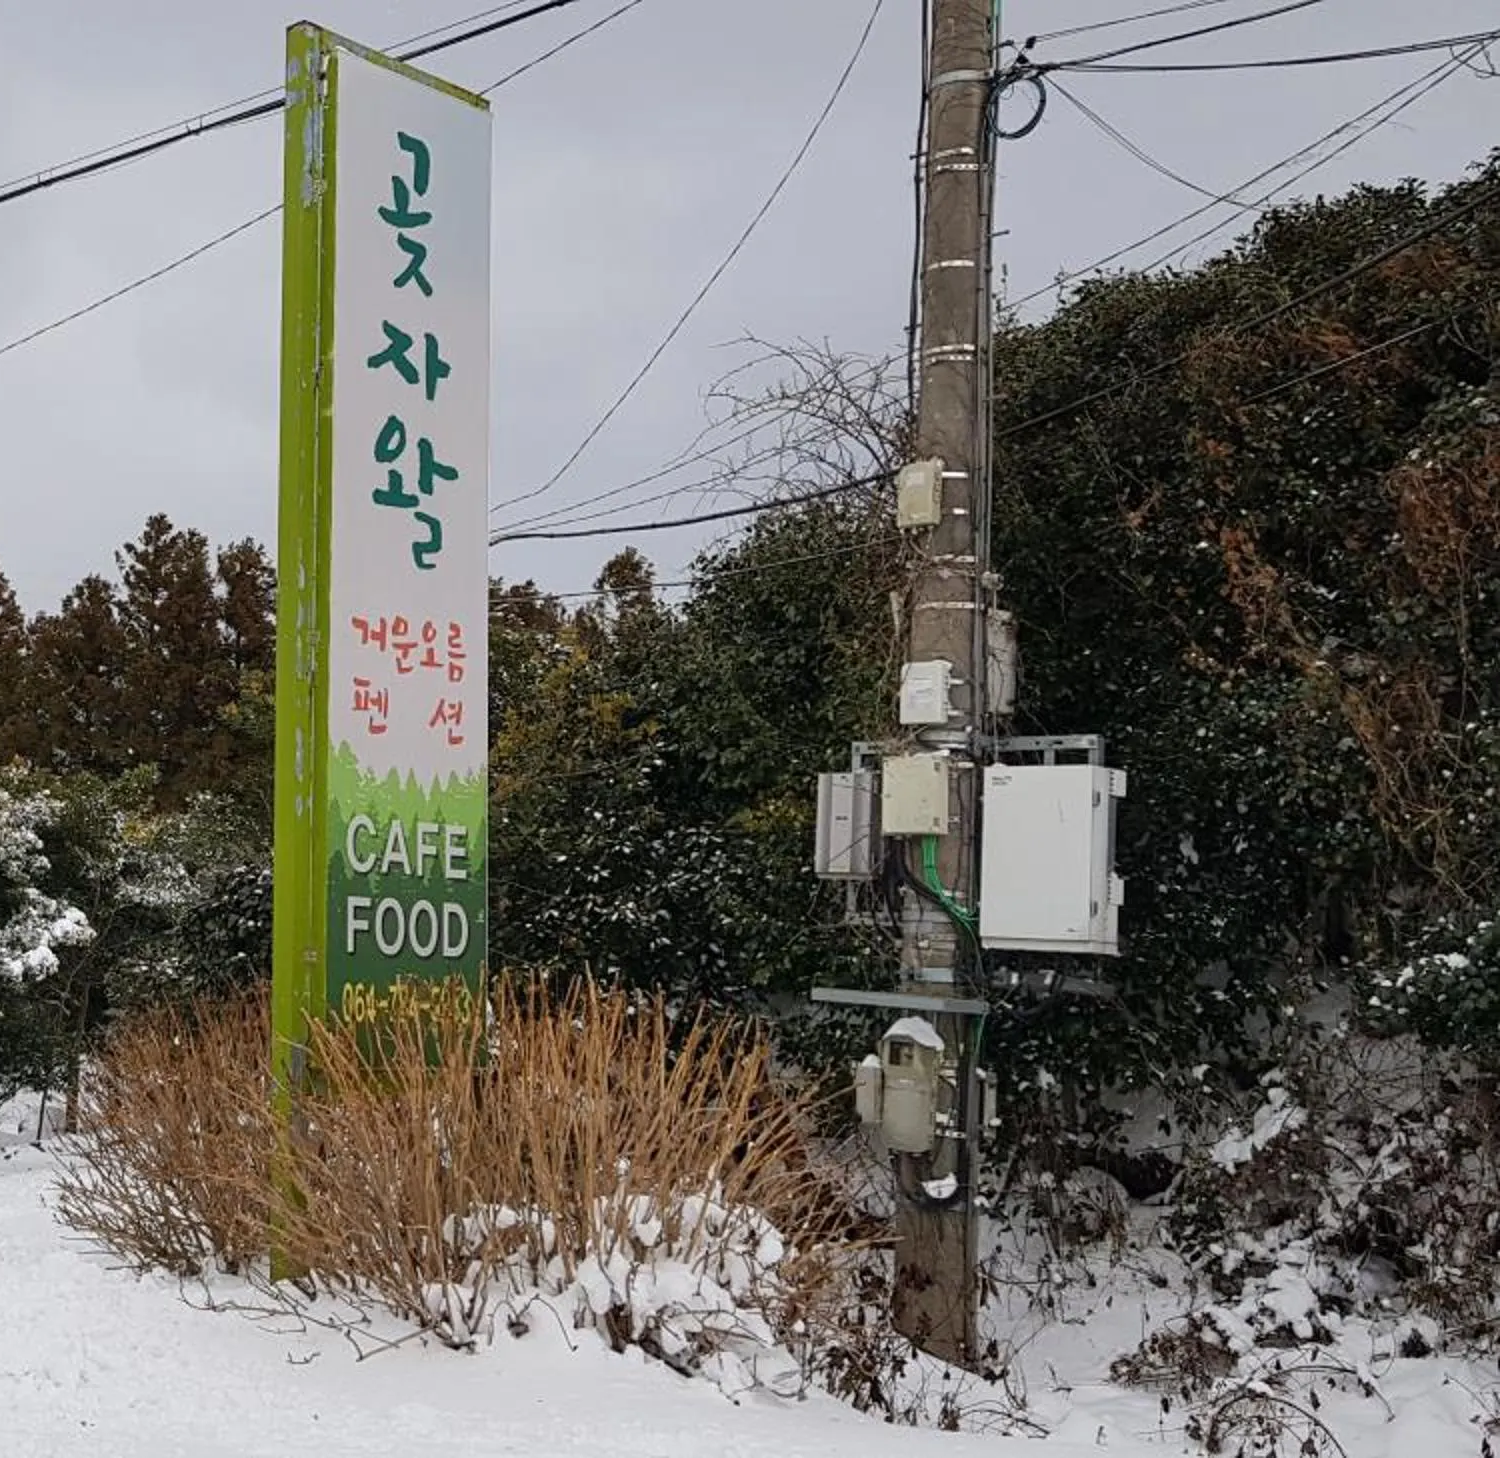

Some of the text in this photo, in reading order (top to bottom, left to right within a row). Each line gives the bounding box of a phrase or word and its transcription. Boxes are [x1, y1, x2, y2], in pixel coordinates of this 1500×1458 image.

[366, 131, 459, 570] 곶자왈
[346, 813, 468, 879] CAFE
[346, 896, 470, 958] FOOD
[342, 981, 472, 1024] 064-74-53
